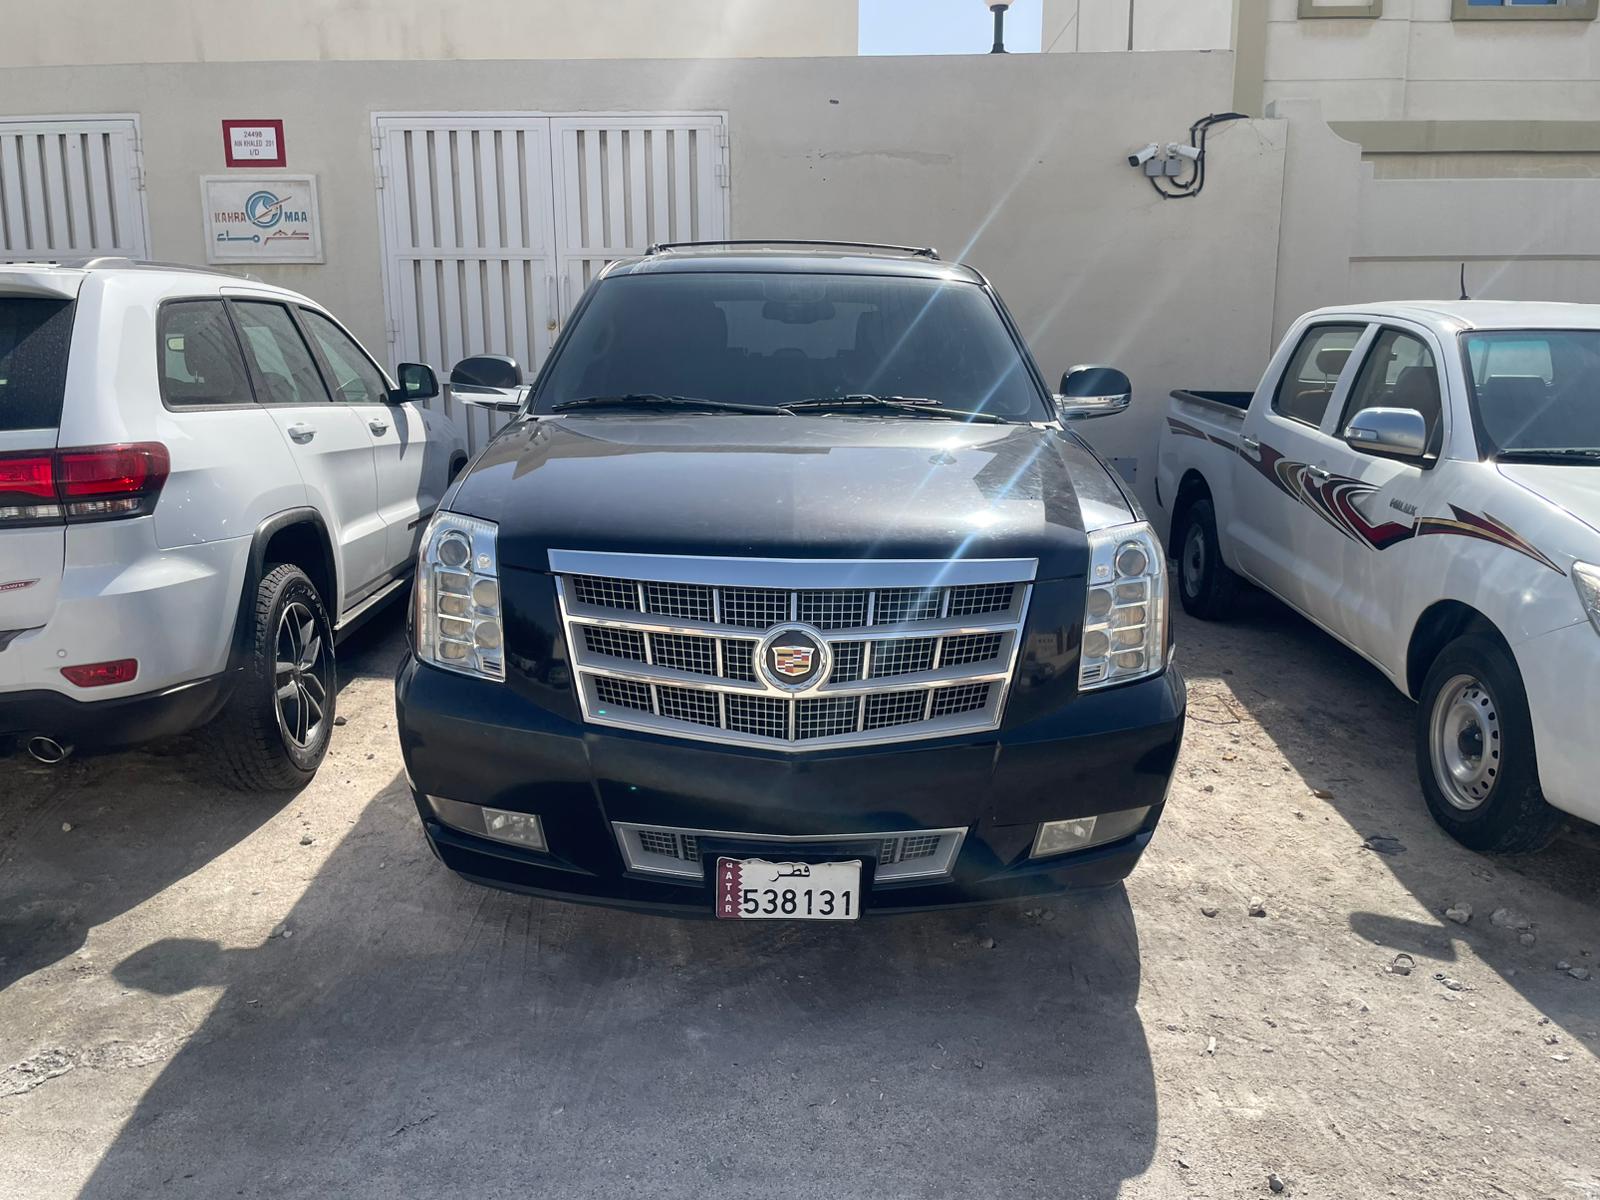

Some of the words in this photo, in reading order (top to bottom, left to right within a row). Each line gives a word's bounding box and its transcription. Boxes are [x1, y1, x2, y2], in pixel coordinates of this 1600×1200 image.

[214, 212, 247, 223] KAHRA
[284, 211, 308, 222] MAA
[725, 862, 733, 912] QATAR
[743, 888, 851, 915] 538131
